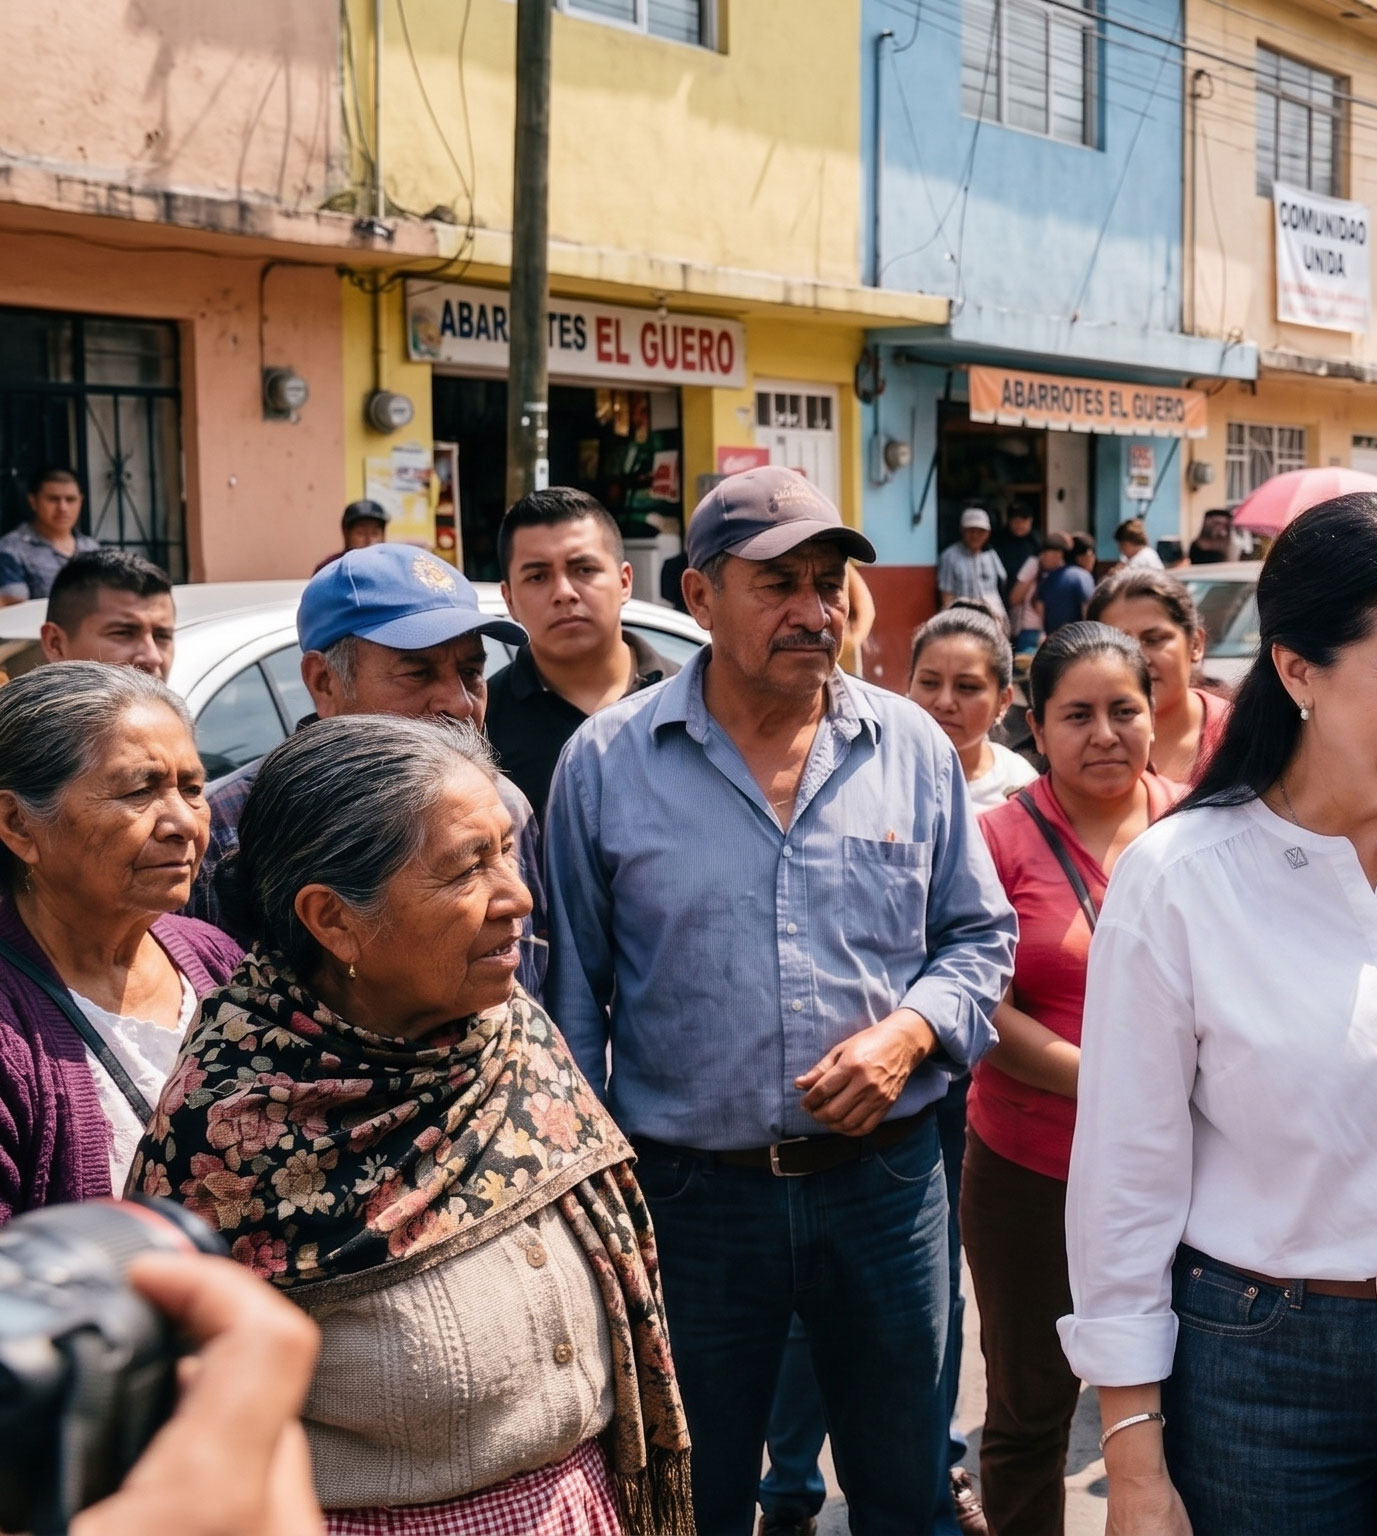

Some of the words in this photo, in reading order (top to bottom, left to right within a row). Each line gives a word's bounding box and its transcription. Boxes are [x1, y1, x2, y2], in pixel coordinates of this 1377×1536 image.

[1303, 245, 1347, 279] UNIDA
[440, 299, 587, 352] ABARTES
[595, 316, 631, 365] EL
[1001, 377, 1105, 416] ABARROTES
[1109, 389, 1129, 419] EL
